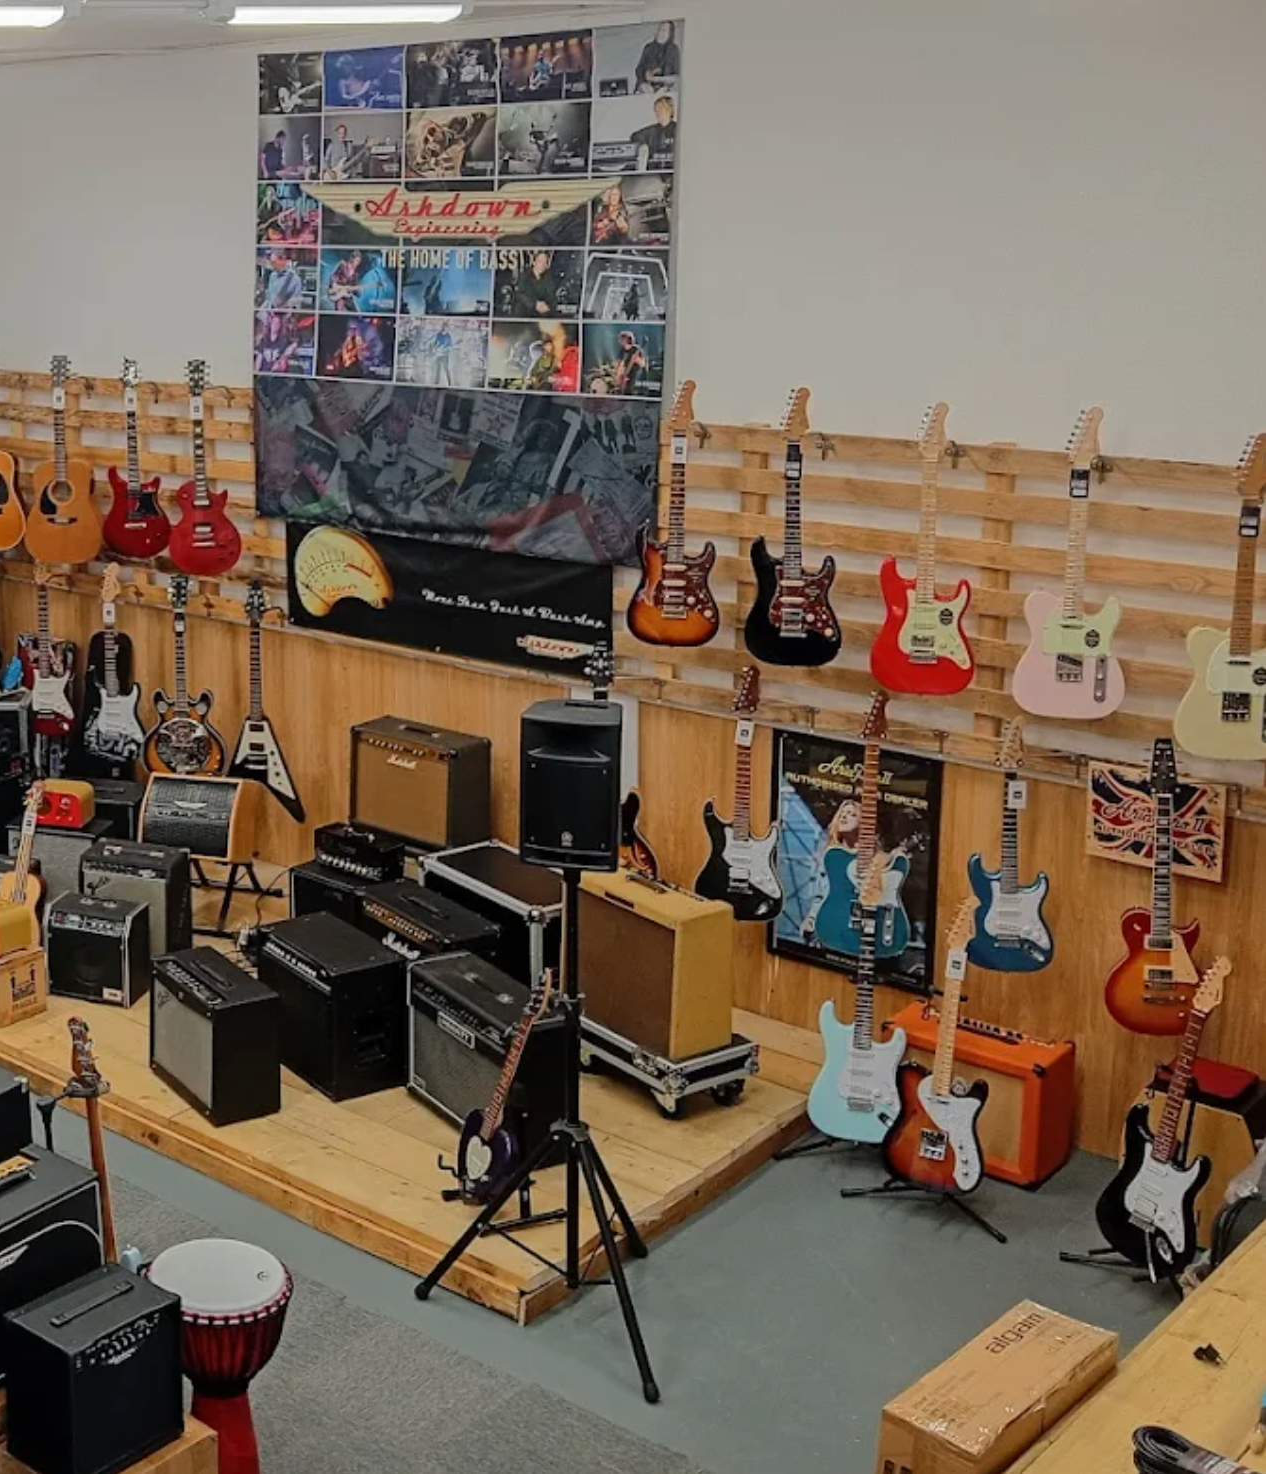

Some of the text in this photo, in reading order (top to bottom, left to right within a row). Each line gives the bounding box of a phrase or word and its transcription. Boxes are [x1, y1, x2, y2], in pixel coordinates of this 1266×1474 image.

[365, 187, 542, 217] Ashdown
[393, 218, 503, 238] Engineering
[382, 250, 405, 269] THE
[410, 250, 450, 269] HOME
[455, 250, 475, 269] OF
[986, 1311, 1047, 1355] algam
